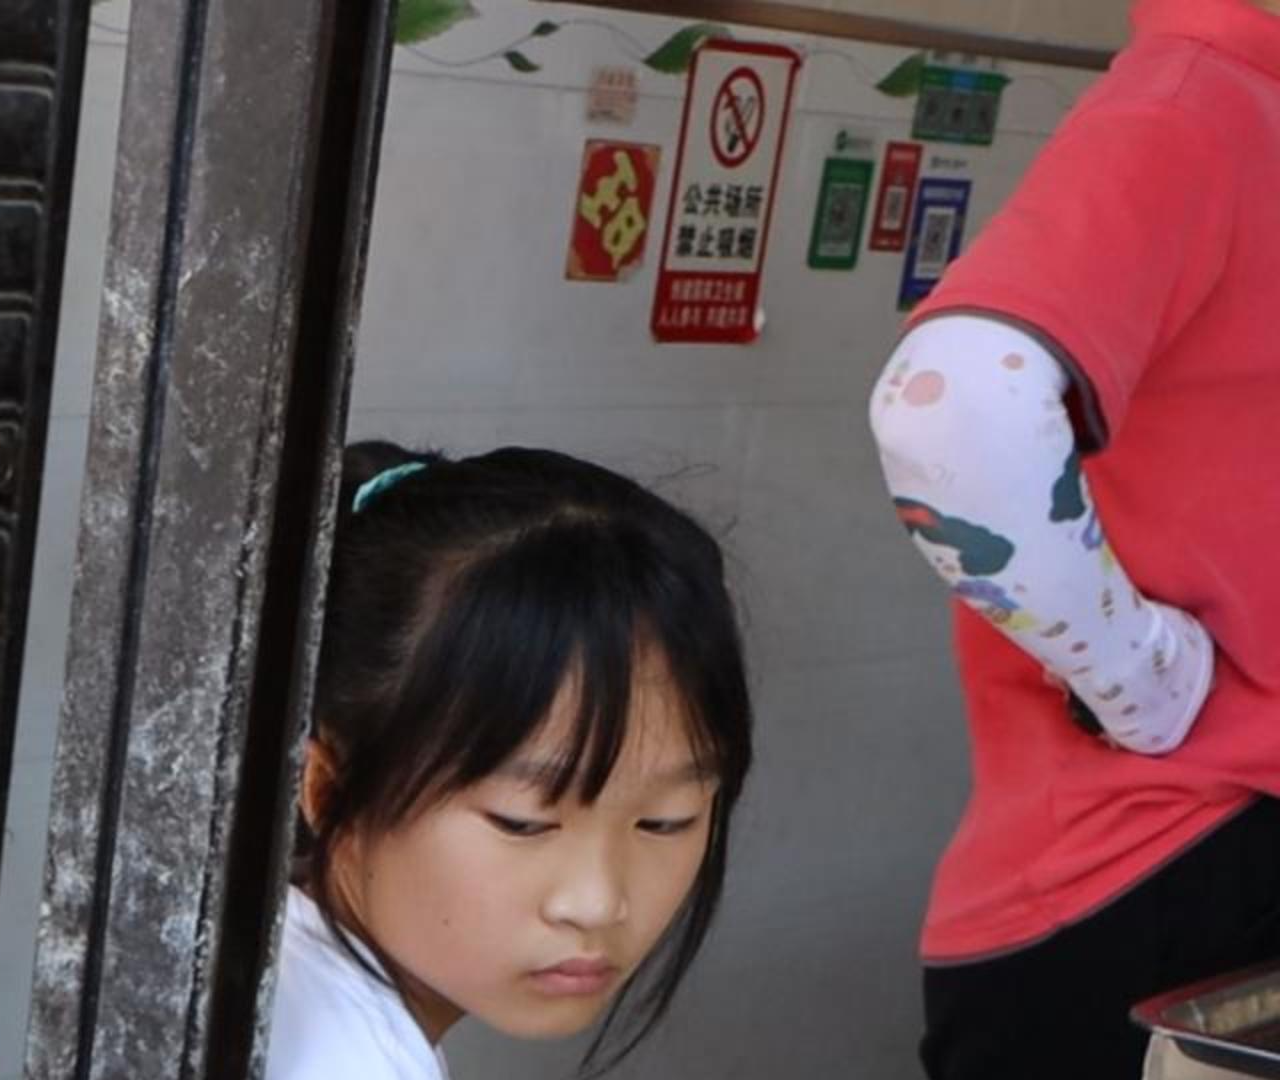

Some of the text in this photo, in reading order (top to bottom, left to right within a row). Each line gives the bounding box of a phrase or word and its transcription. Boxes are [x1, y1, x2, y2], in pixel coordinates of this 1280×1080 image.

[684, 183, 763, 217] 公共场所
[676, 225, 758, 259] 禁止吸烟
